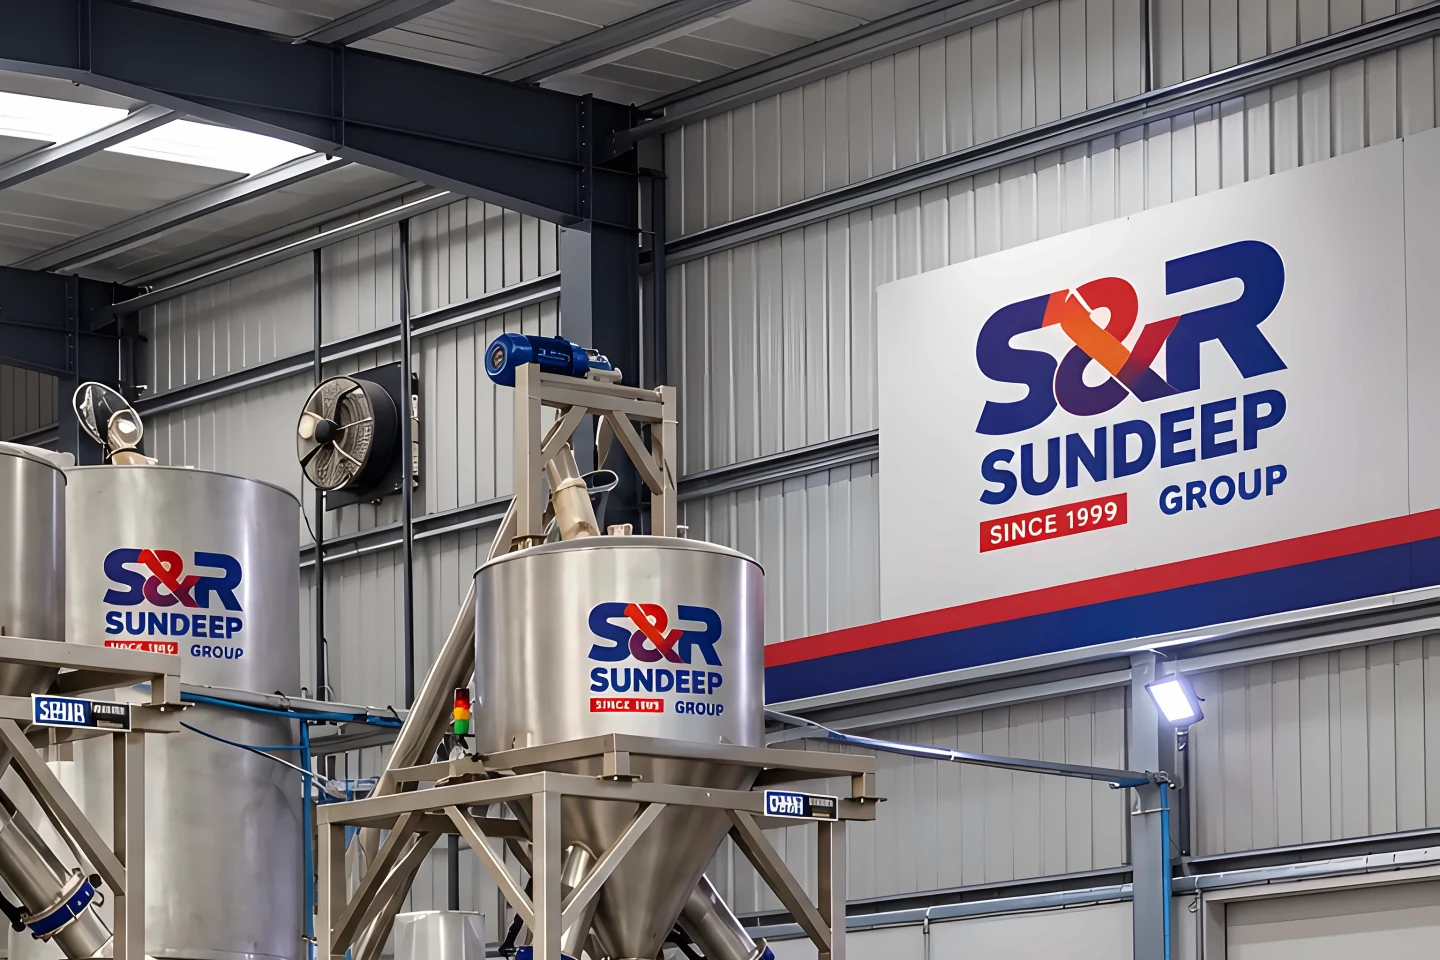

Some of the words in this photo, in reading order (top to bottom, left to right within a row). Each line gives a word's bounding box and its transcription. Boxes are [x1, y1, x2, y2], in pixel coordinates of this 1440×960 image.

[975, 240, 1288, 436] S&R
[979, 389, 1288, 505] SUNDEEP
[1159, 464, 1288, 515] GROUP
[990, 514, 1058, 544] SINCE
[1066, 502, 1118, 529] 1999
[103, 548, 244, 612] S&R
[105, 611, 243, 639] SUNDEEP
[588, 602, 723, 667] S&R
[190, 644, 244, 660] GROUP
[590, 667, 723, 695] SUNDEEP
[675, 700, 724, 716] GROUP
